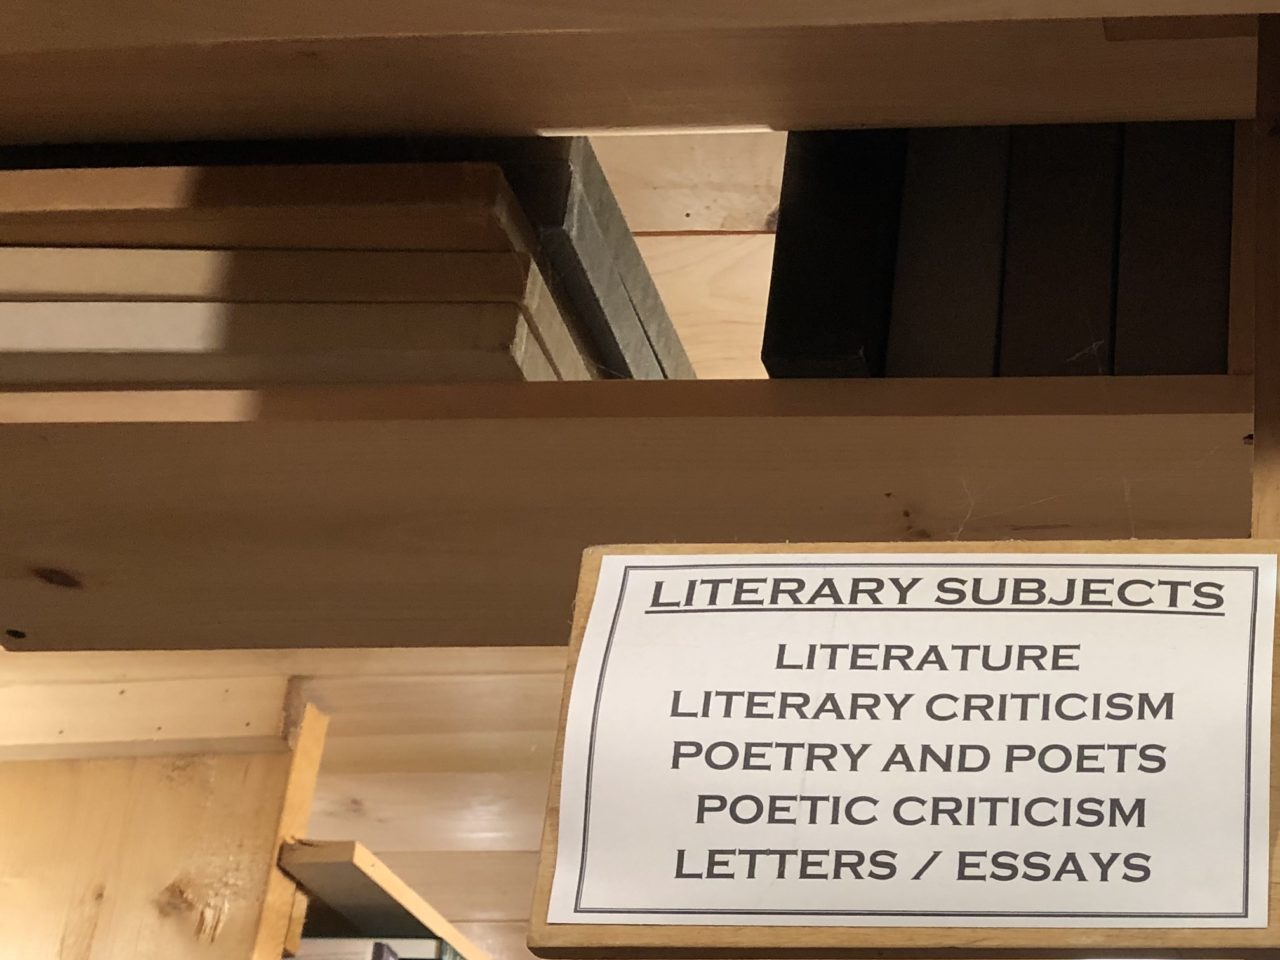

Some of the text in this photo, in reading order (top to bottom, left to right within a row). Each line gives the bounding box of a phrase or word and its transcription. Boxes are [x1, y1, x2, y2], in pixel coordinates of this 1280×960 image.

[649, 578, 1225, 609] LITERARY SUBJECTS
[775, 644, 1081, 671] LITERATURE
[670, 691, 1174, 721] LITERARY CRITICISM
[671, 741, 1167, 773] POETRY AND POETS
[695, 795, 1146, 828] POETIC CRITICISM
[674, 848, 1151, 882] LETTERS / ESSAYS
